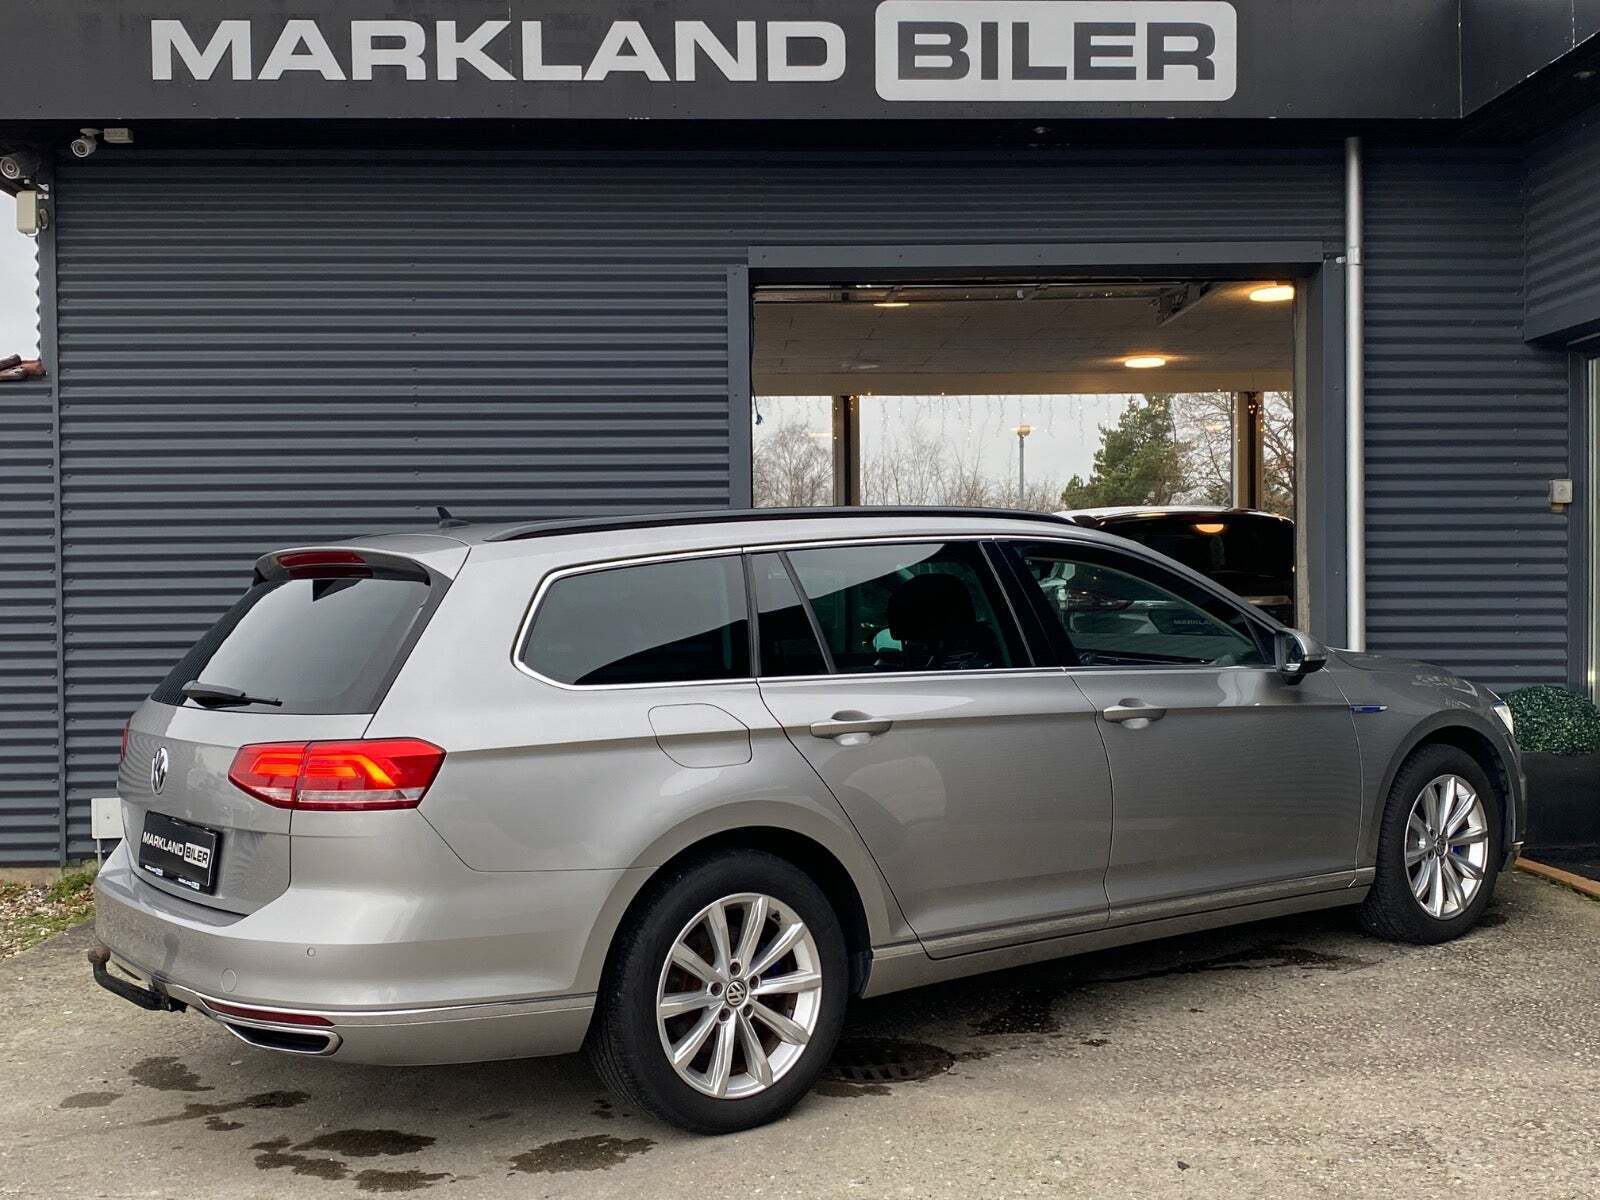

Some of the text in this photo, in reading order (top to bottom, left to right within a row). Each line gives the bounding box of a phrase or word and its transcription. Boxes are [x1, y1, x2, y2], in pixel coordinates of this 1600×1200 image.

[151, 19, 1216, 81] MARKLAND BILER
[142, 832, 208, 865] MARKLAND BILER
